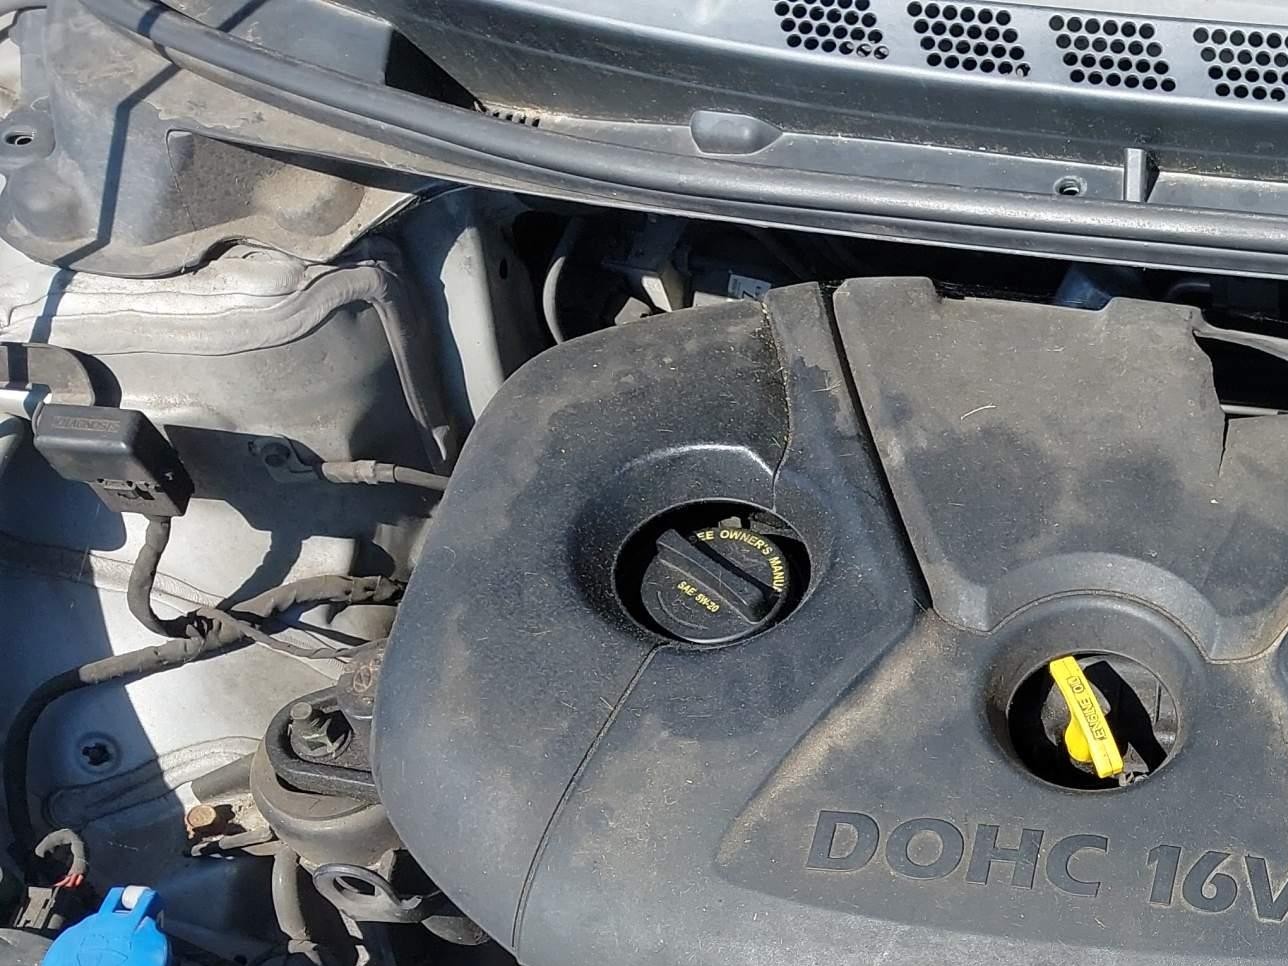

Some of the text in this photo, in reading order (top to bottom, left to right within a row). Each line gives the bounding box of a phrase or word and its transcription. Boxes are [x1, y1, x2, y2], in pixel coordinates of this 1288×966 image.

[720, 530, 773, 555] OWNER'S
[677, 581, 720, 612] SAE 5W-20
[806, 810, 1108, 898] DOHC
